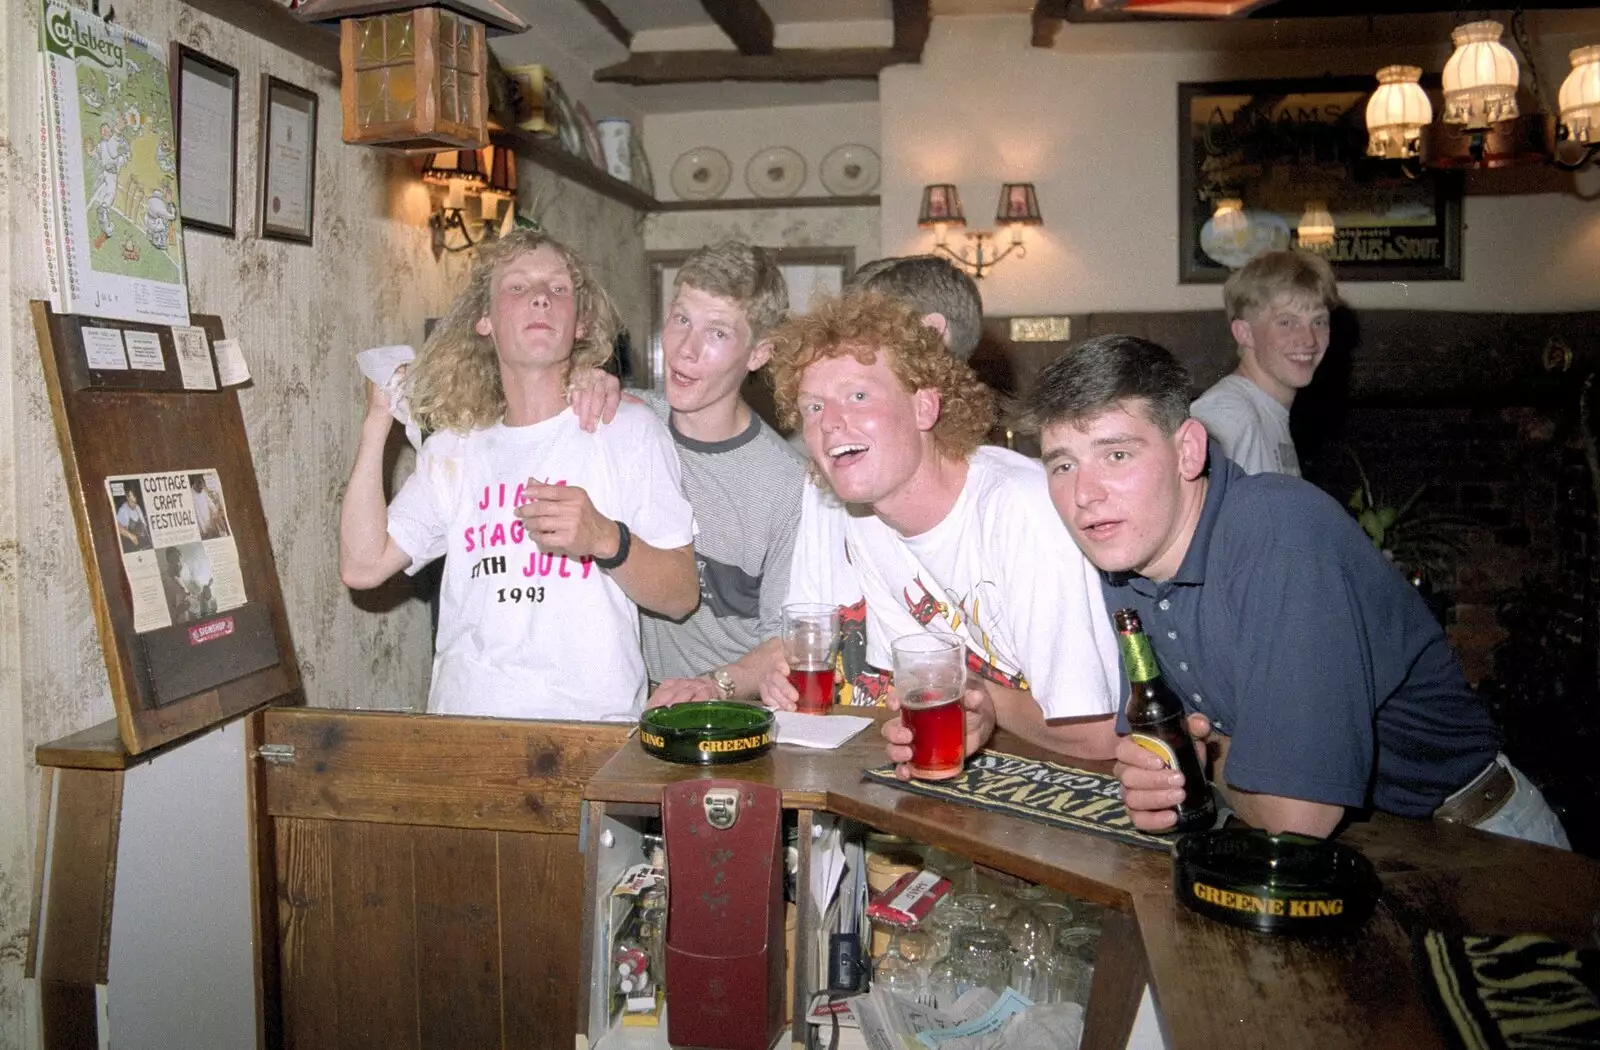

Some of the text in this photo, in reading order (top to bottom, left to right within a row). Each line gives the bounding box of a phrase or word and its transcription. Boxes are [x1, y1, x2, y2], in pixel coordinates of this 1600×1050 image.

[47, 8, 123, 68] Carlsberg
[95, 290, 119, 308] JULY
[143, 474, 188, 493] COTTAGE
[153, 493, 184, 511] CRAFT
[150, 511, 196, 531] FESTIVAL
[523, 551, 594, 580] JULY
[497, 586, 546, 604] 1993
[698, 735, 760, 753] GREENE
[1193, 881, 1344, 918] GREENE KING
